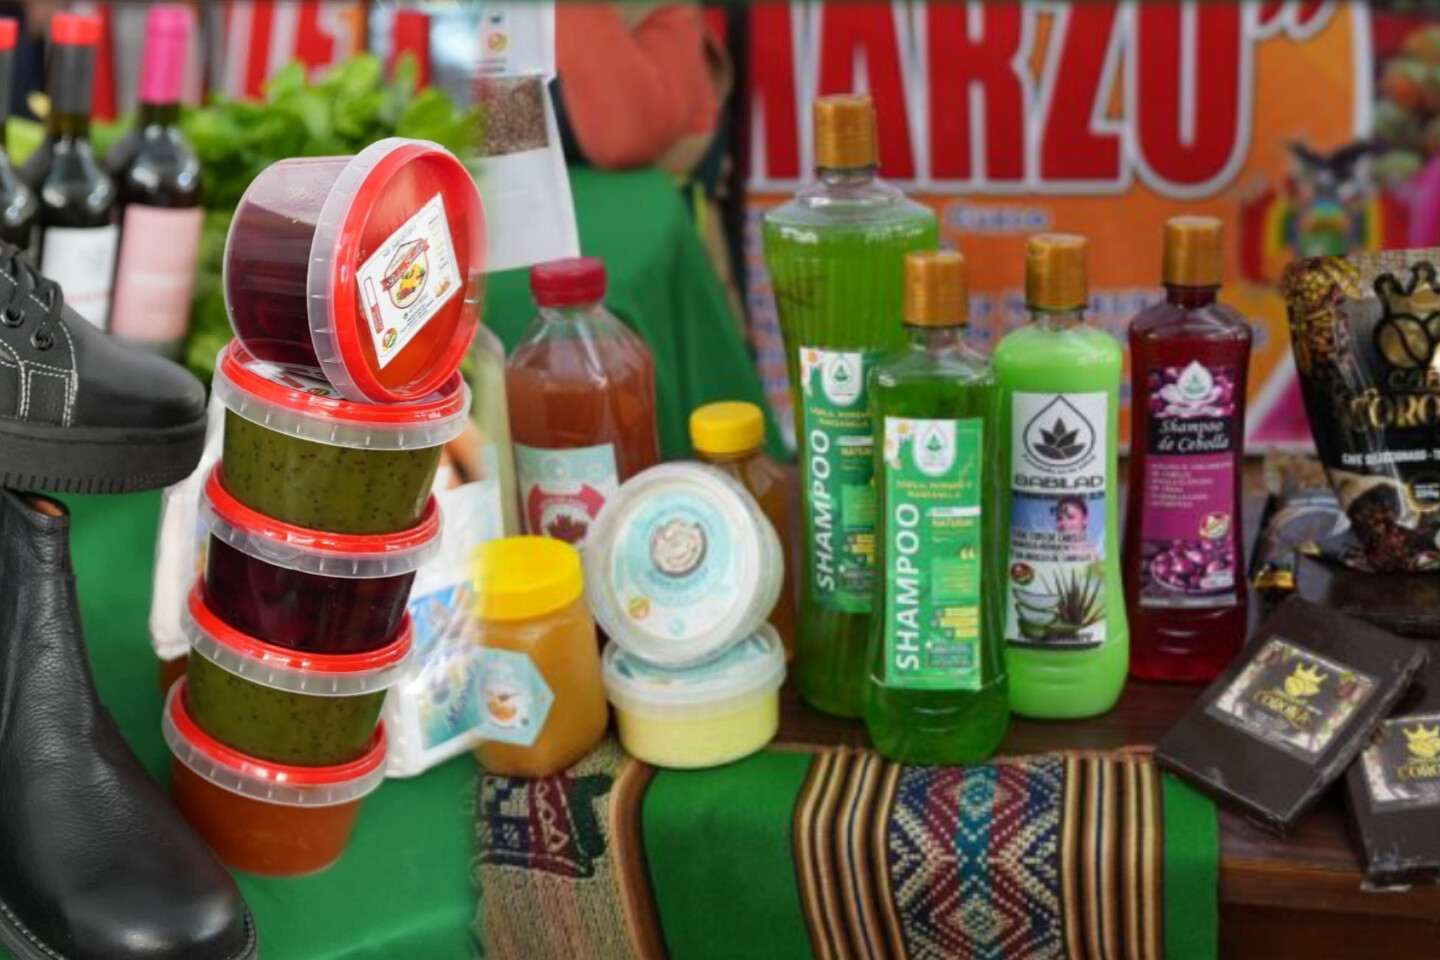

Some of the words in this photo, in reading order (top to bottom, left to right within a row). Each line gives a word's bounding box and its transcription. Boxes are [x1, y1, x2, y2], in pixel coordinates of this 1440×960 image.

[1157, 436, 1174, 452] de
[1177, 434, 1230, 452] Cebolla
[1158, 418, 1225, 436] Shampoo
[811, 429, 835, 592] SHAMPOO
[894, 503, 920, 671] SHAMPOO
